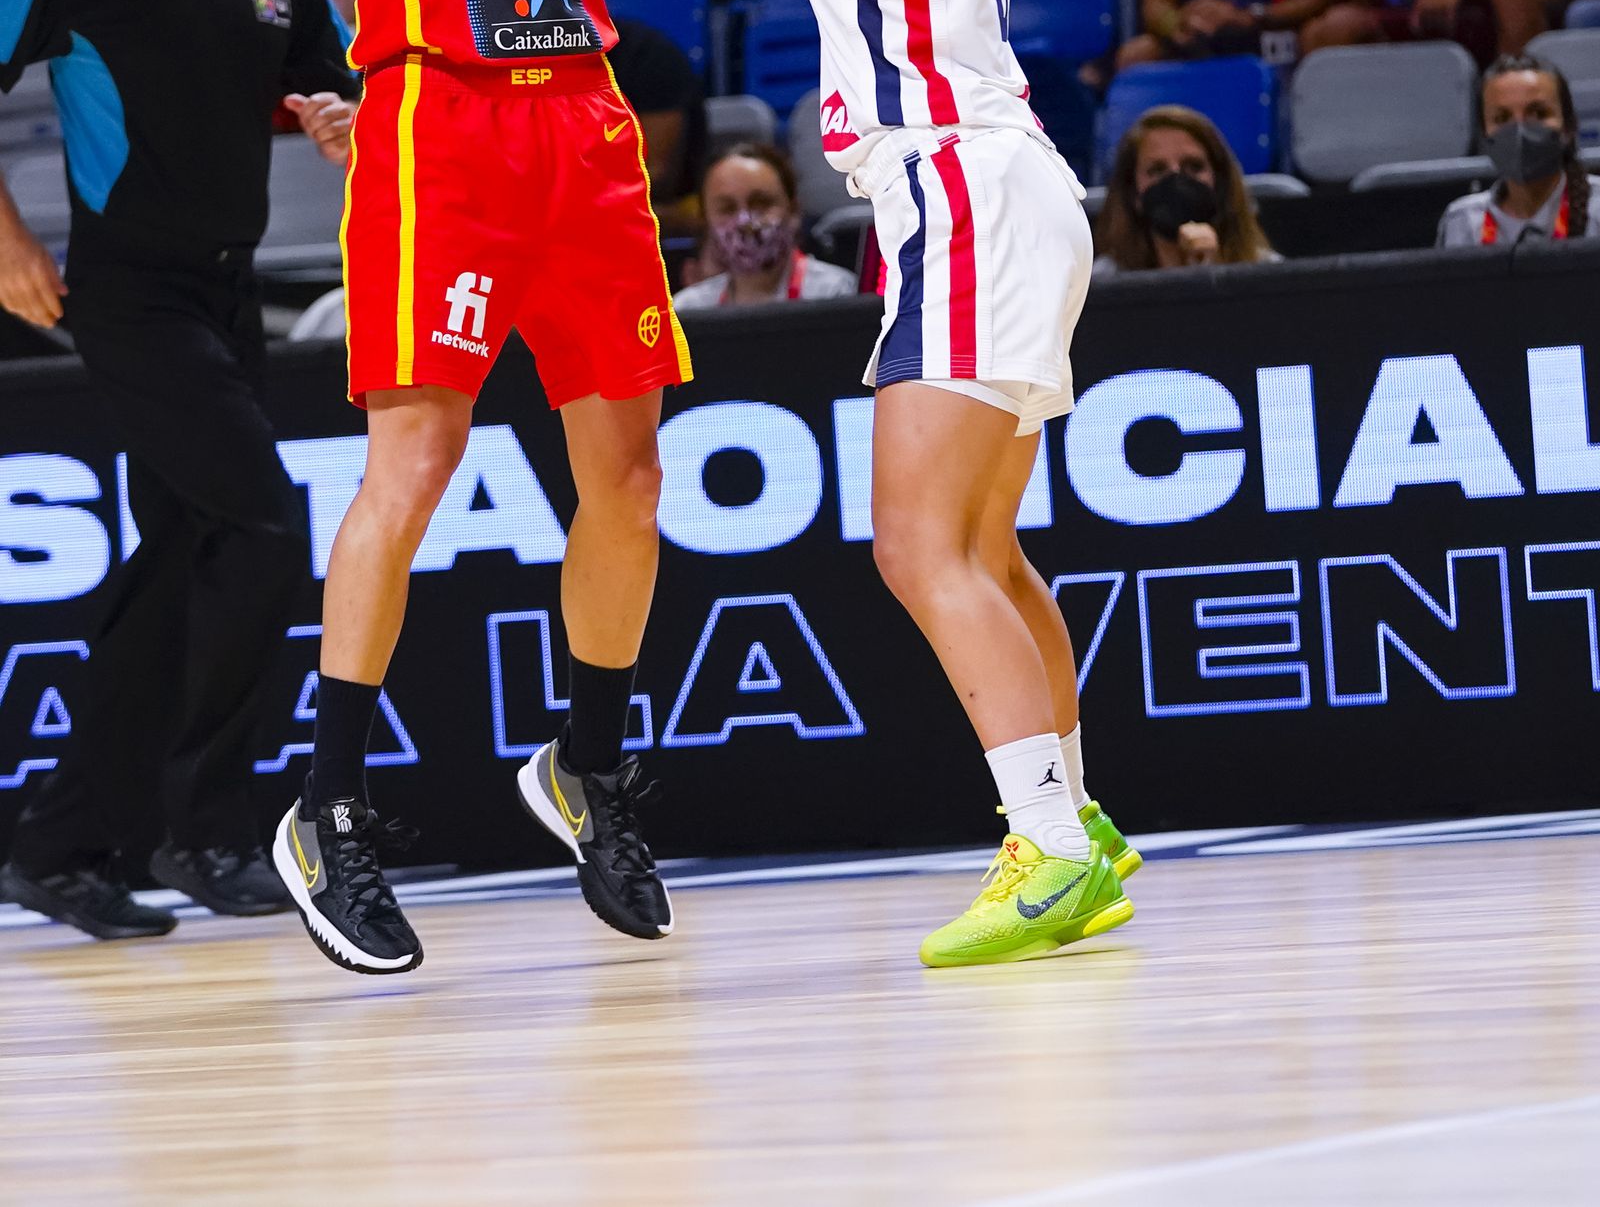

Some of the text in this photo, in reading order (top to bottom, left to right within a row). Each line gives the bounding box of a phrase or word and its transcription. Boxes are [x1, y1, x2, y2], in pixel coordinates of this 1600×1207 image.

[494, 24, 591, 51] CaixaBank
[511, 68, 552, 85] ESP
[445, 271, 493, 339] fi
[431, 330, 490, 358] network
[487, 593, 867, 759] LA
